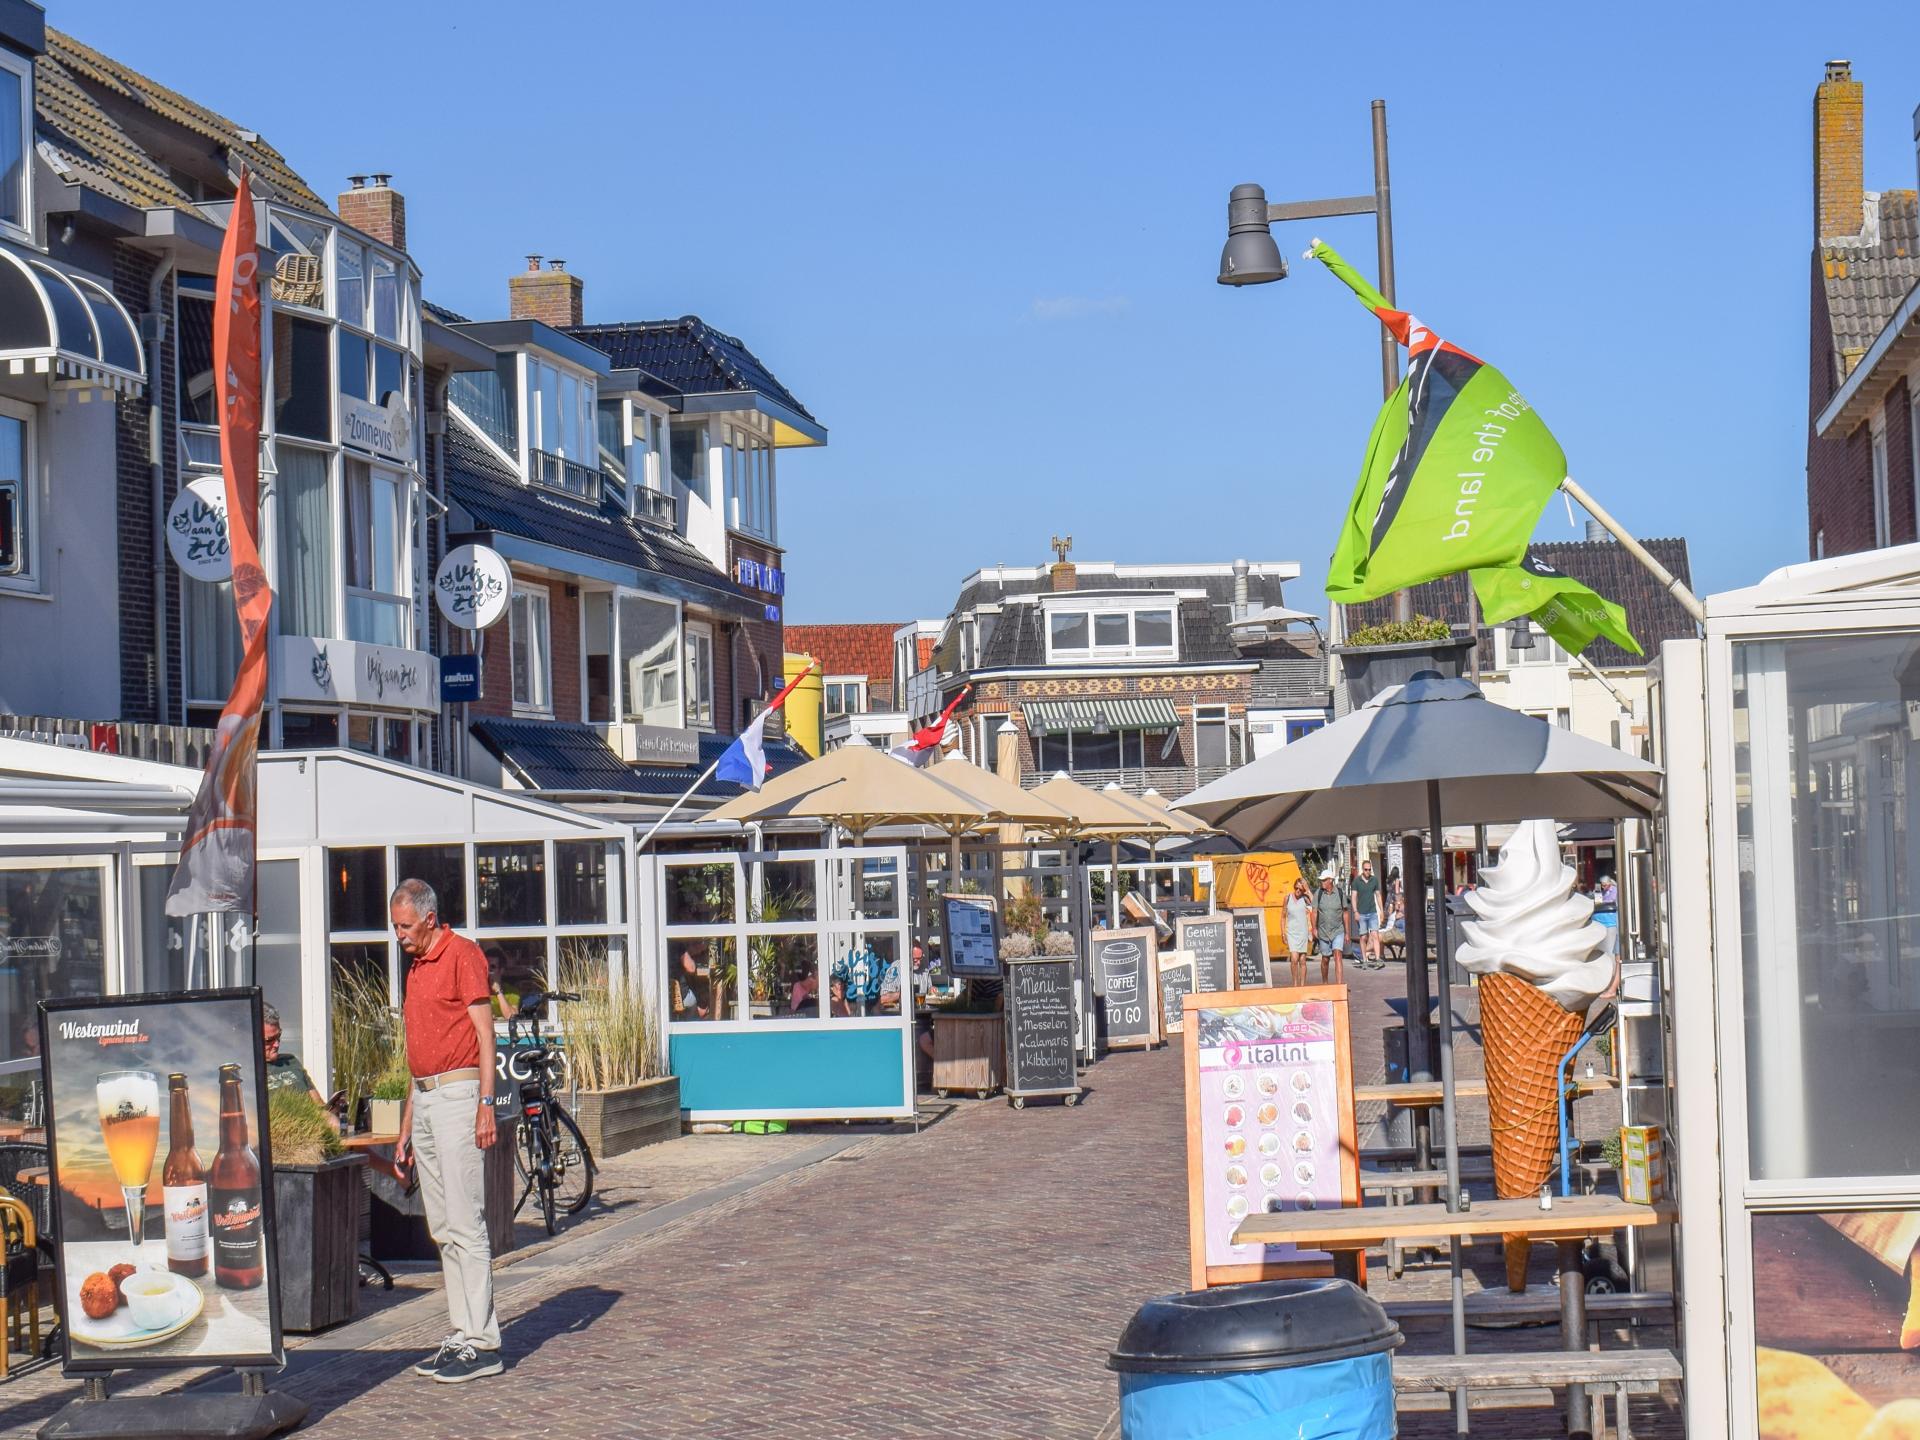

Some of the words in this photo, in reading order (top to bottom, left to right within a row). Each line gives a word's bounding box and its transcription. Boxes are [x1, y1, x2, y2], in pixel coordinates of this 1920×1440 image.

[350, 412, 392, 452] Zonnevis
[191, 525, 213, 535] aan
[1186, 925, 1218, 938] Geniet
[1020, 976, 1058, 995] Menu
[1108, 976, 1136, 990] COFFEE
[1106, 1008, 1122, 1024] TO
[1125, 1006, 1142, 1024] GO
[59, 1018, 140, 1040] Westenwind
[1024, 1017, 1068, 1031] Mosselen
[1024, 1033, 1069, 1048] Calamaris
[1247, 1042, 1310, 1064] italini
[1026, 1048, 1068, 1075] Kibbeling
[496, 1093, 512, 1105] us!
